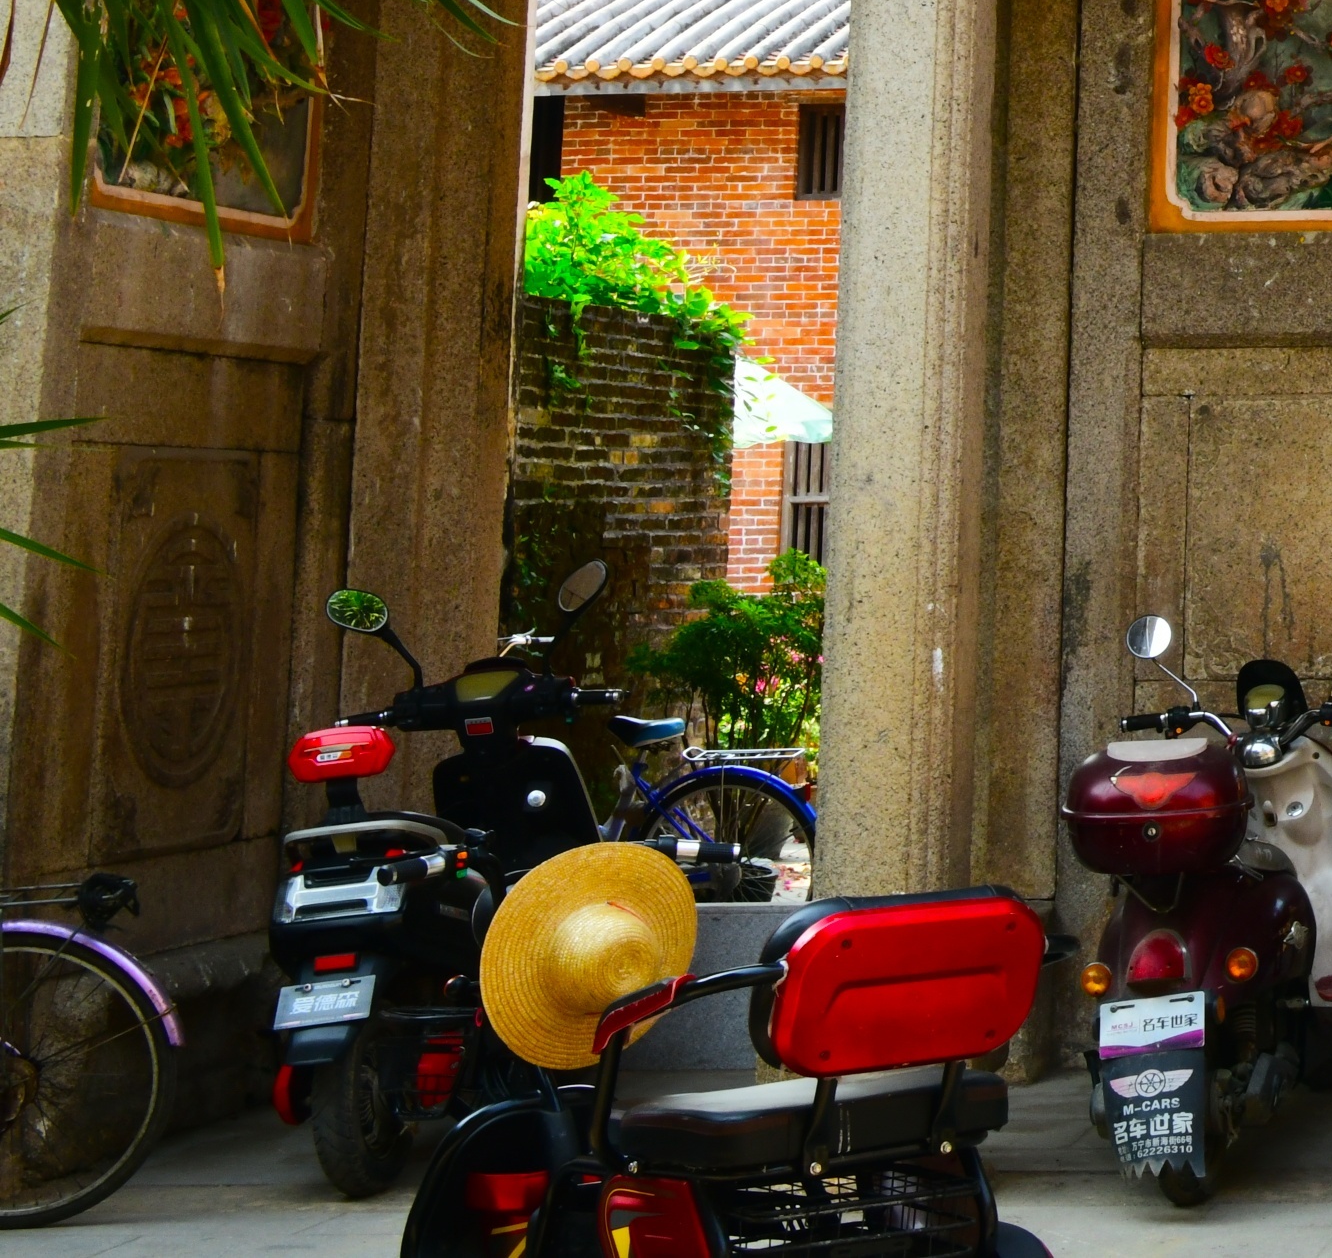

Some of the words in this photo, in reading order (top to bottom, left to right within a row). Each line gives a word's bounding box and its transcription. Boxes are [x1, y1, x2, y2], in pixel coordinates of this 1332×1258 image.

[1143, 1013, 1198, 1032] 名车世家
[1122, 1097, 1181, 1117] M-CARS
[1113, 1111, 1194, 1145] 名车世家
